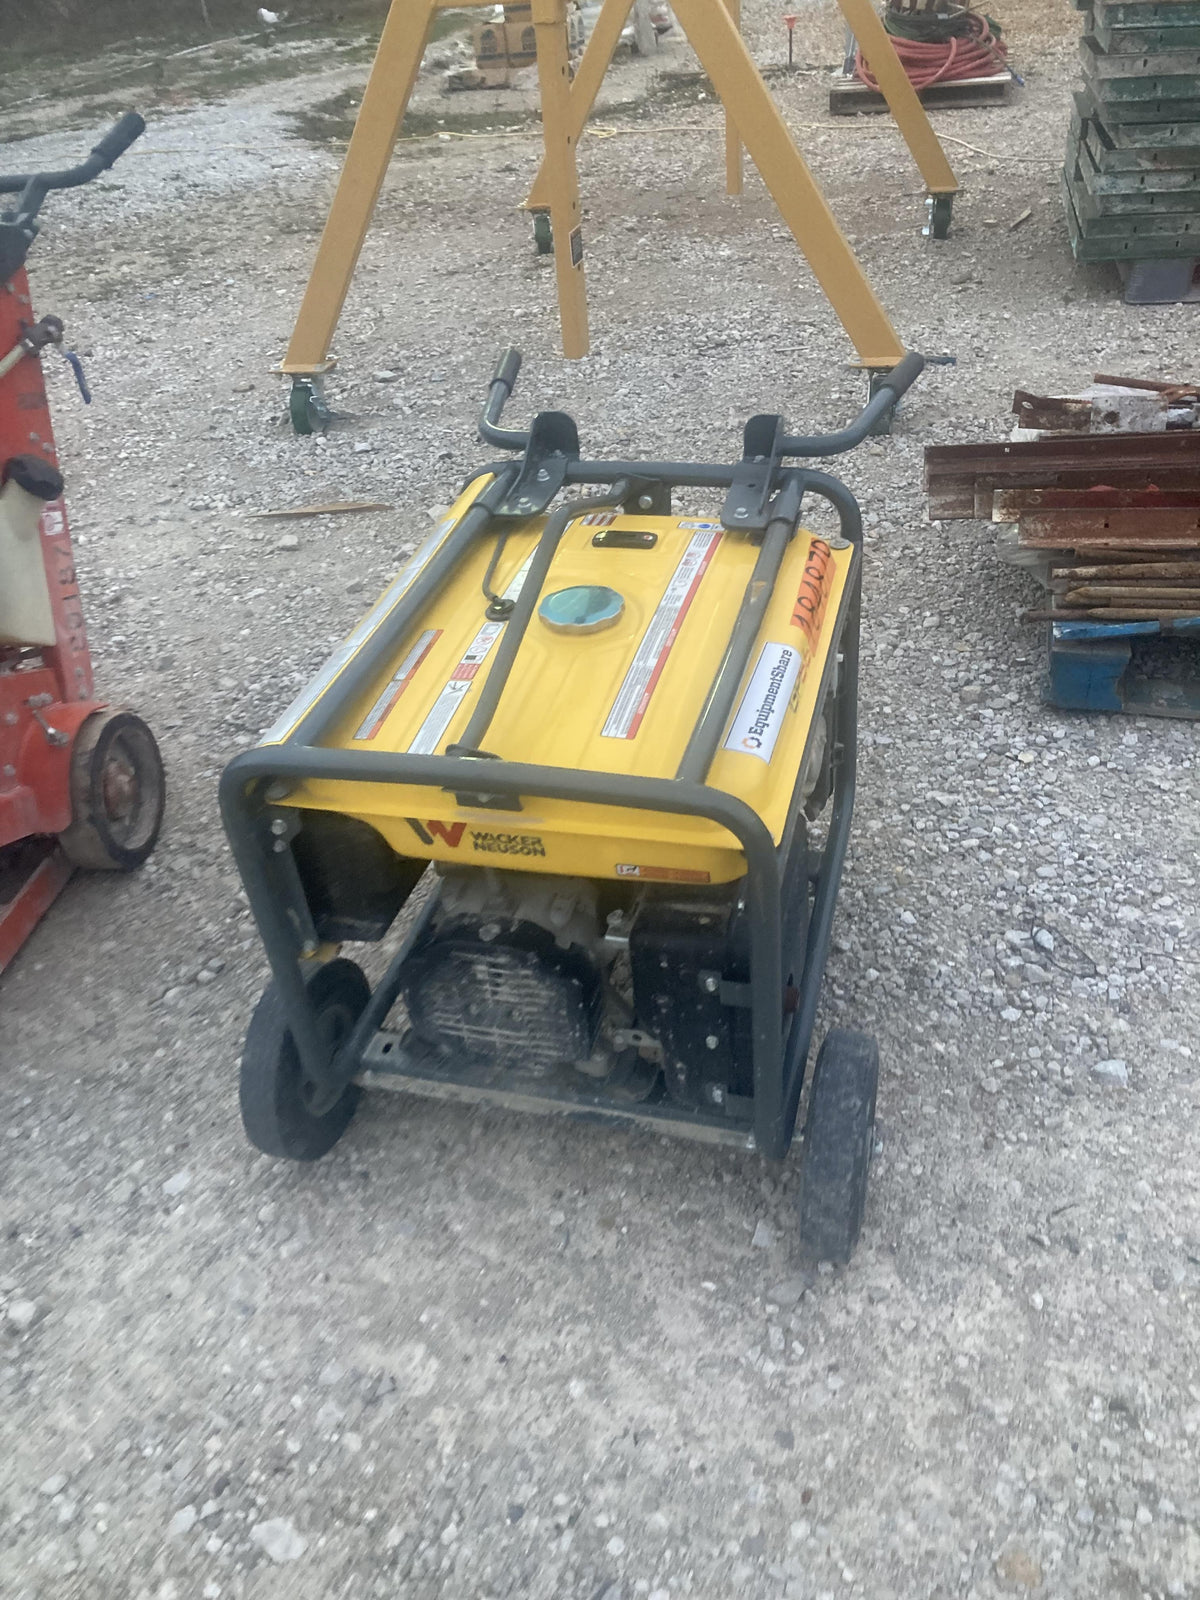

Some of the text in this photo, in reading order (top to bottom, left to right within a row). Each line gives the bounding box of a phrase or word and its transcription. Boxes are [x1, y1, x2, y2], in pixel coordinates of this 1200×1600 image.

[747, 649, 793, 736] EquipmentShare
[470, 831, 543, 846] WACKER
[473, 840, 546, 856] NEUSON
